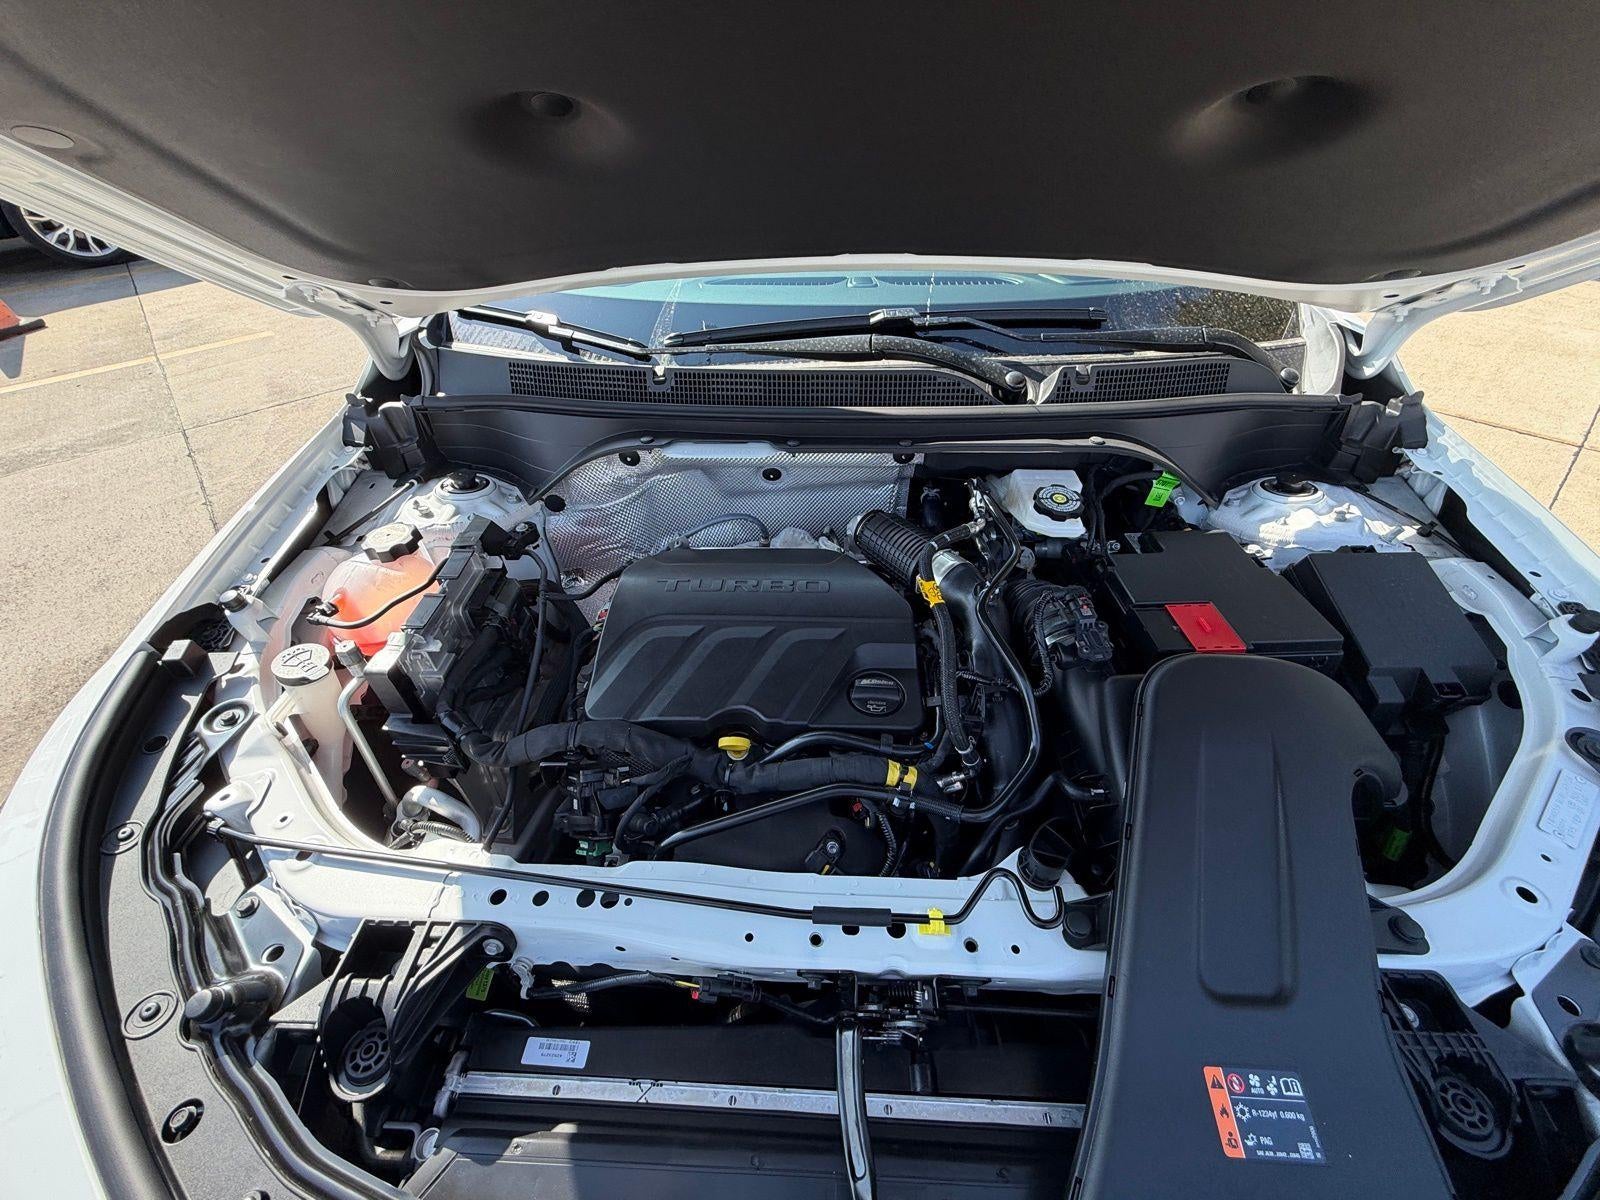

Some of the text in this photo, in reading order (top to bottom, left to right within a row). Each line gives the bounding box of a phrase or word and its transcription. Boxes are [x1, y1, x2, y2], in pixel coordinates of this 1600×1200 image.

[657, 577, 831, 594] TURBO
[1251, 1087, 1265, 1095] AUTO
[1252, 1109, 1278, 1120] R-1234yf
[1296, 1112, 1306, 1122] kg
[1259, 1136, 1274, 1146] PAG
